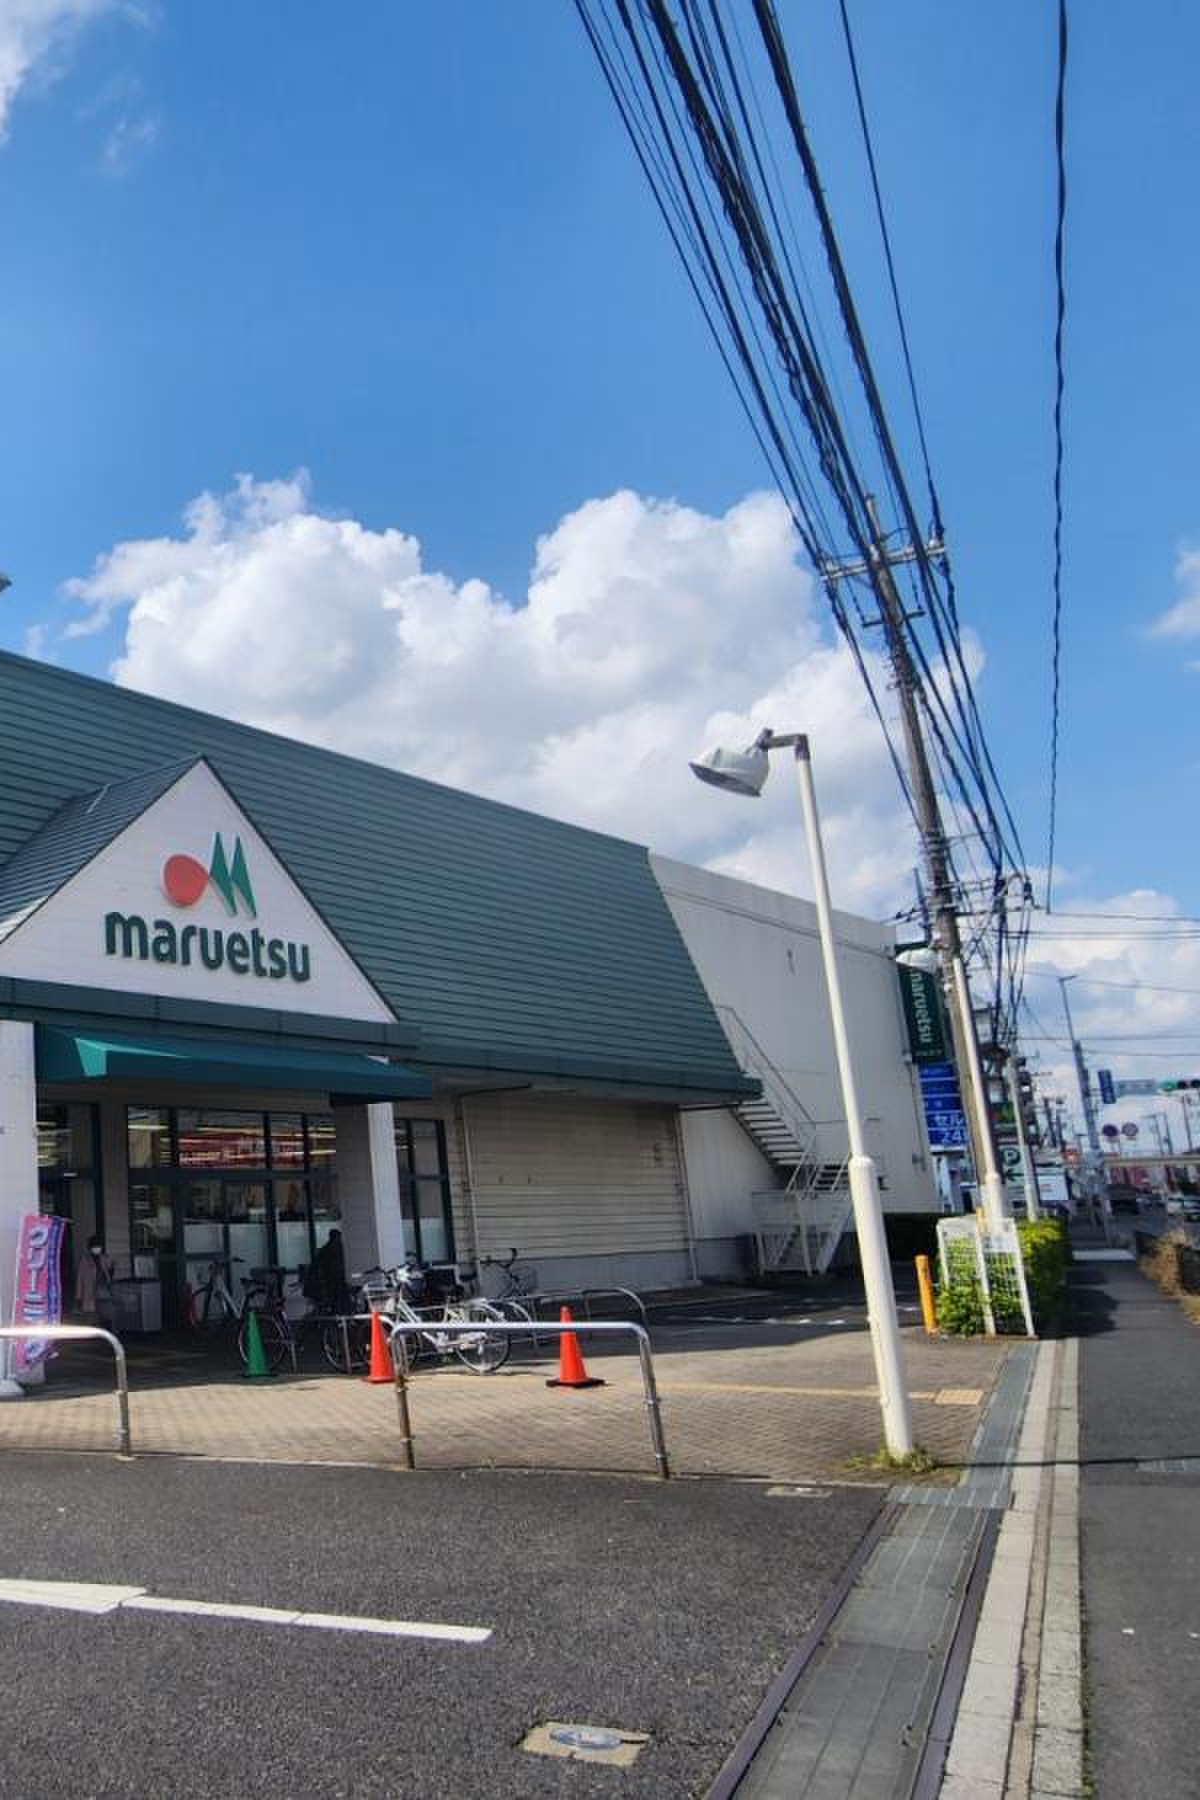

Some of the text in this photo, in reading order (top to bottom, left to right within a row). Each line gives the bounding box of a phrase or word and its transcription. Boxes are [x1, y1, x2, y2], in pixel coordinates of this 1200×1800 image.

[104, 911, 311, 983] maruetsu
[23, 1226, 50, 1361] クリーニグ
